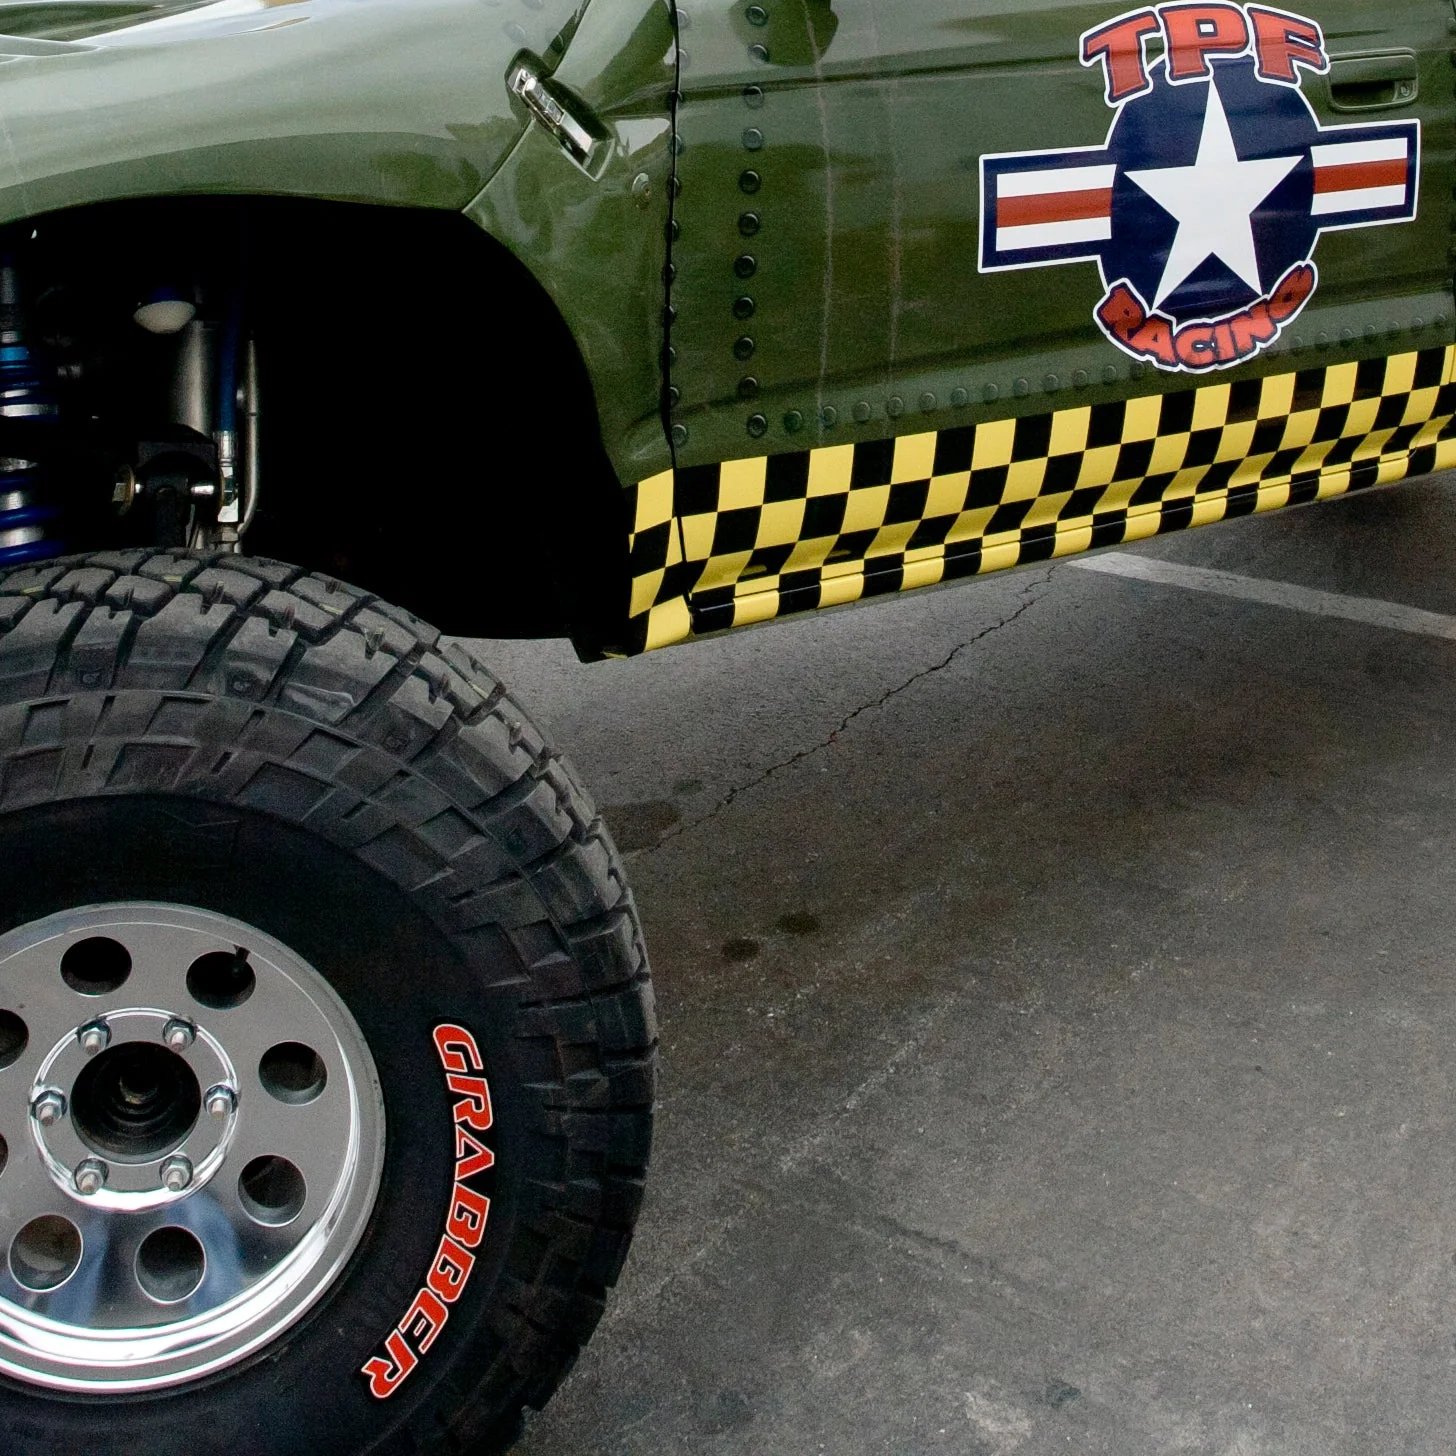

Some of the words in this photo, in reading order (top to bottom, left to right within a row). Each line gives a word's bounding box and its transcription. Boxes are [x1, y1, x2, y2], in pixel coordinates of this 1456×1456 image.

[1081, 1, 1328, 105] TPF
[1095, 262, 1316, 372] RACING
[360, 1022, 496, 1401] GRABBER
